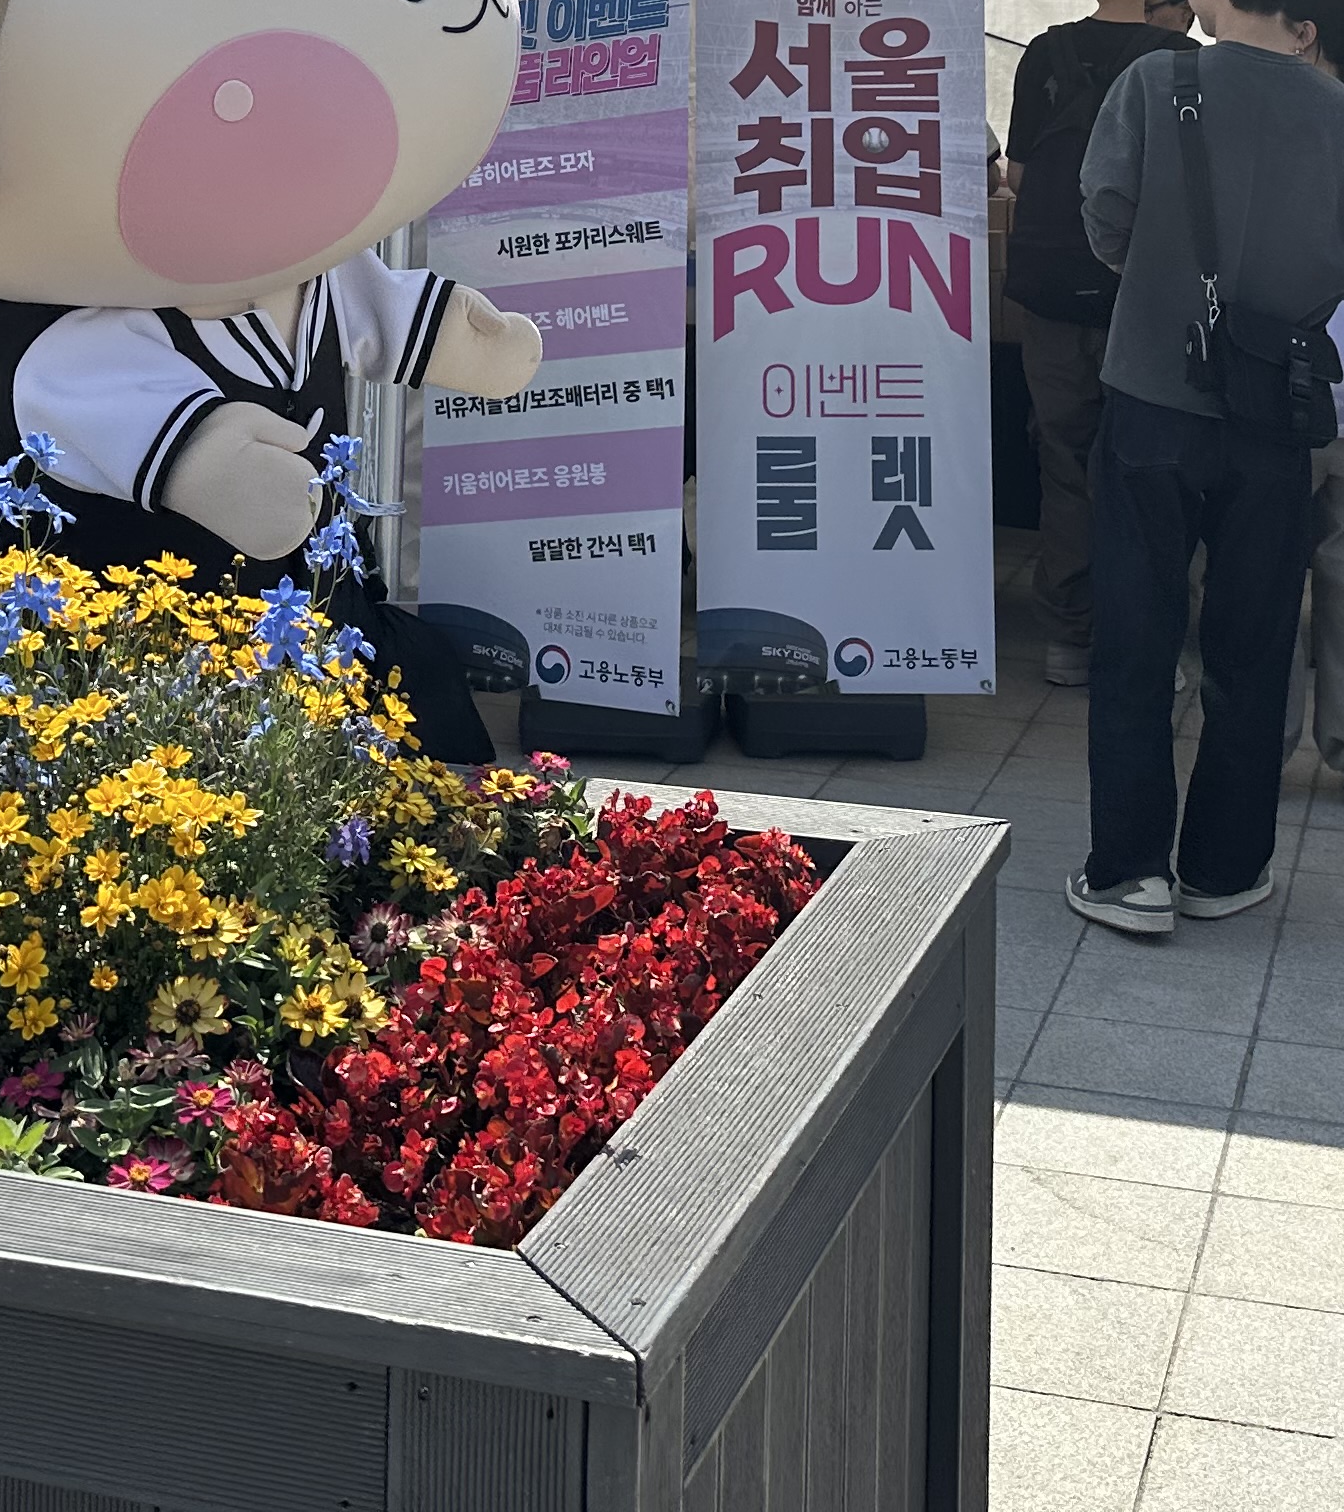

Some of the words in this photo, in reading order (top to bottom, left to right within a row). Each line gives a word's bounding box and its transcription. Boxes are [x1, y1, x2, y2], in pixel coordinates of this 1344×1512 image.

[728, 17, 946, 113] 서울
[461, 157, 556, 188] 움히어로즈
[560, 150, 595, 174] 모자
[733, 116, 942, 217] 취업
[497, 234, 549, 259] 시원한
[555, 220, 663, 251] 포카리스웨트
[713, 216, 972, 343] RUN
[556, 303, 629, 330] 헤어밴드
[623, 381, 641, 402] 중
[646, 378, 675, 400] 택1
[762, 363, 924, 418] 이벤트
[443, 468, 549, 496] 키움히어로즈
[554, 462, 606, 487] 응원봉
[529, 536, 582, 562] 달달한
[587, 534, 622, 558] 간식
[627, 532, 656, 556] 택1
[473, 645, 498, 657] SKY
[761, 646, 791, 657] SKY
[882, 648, 978, 669] 고용노동부
[579, 660, 664, 688] 고용노동부
